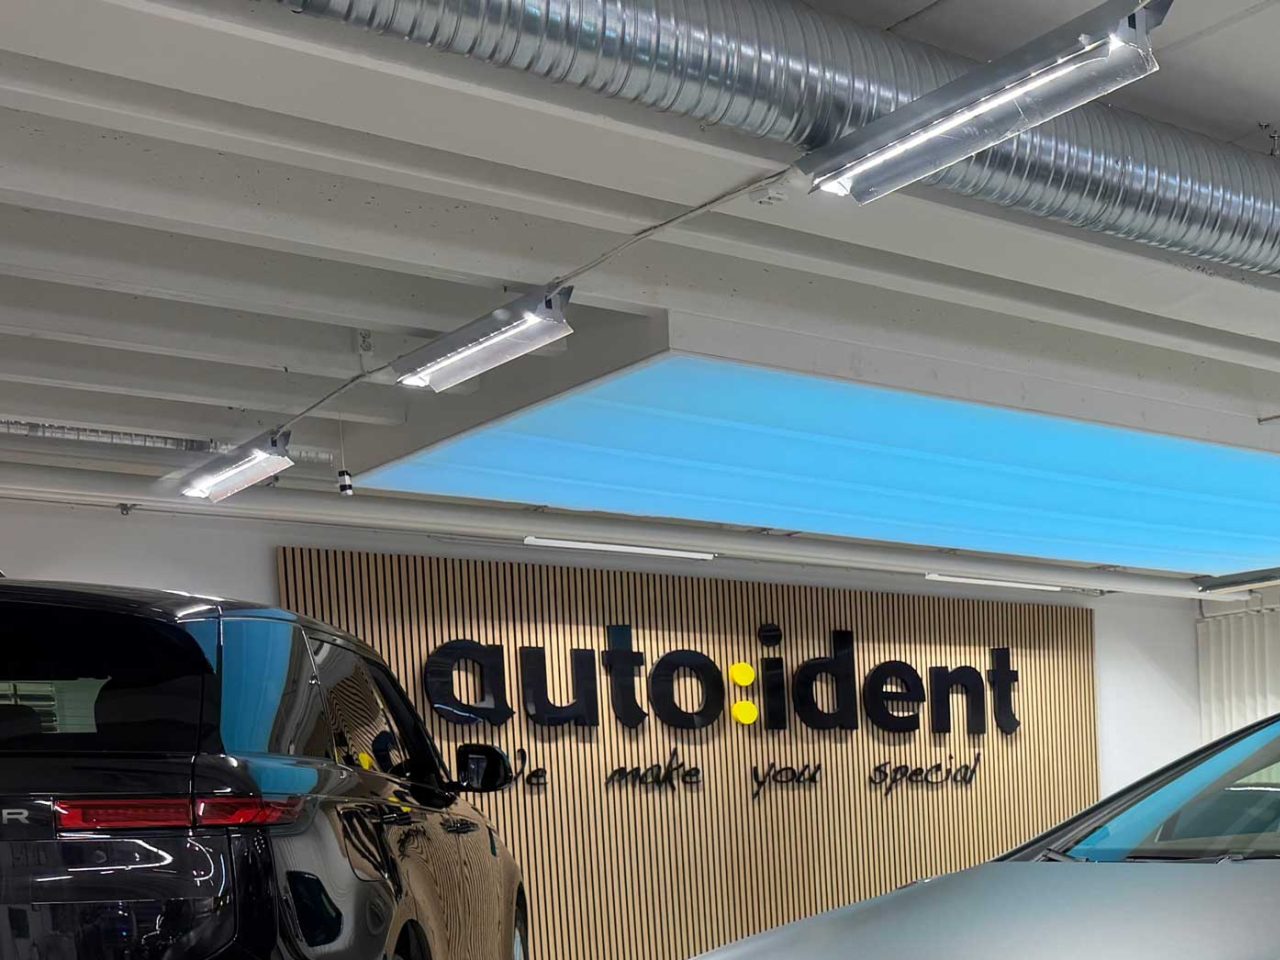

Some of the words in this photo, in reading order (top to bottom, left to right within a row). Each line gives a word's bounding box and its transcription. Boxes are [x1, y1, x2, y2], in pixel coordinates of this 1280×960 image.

[423, 623, 1020, 737] auto:ident
[604, 747, 702, 792] make
[752, 762, 821, 800] you
[868, 752, 981, 797] special
